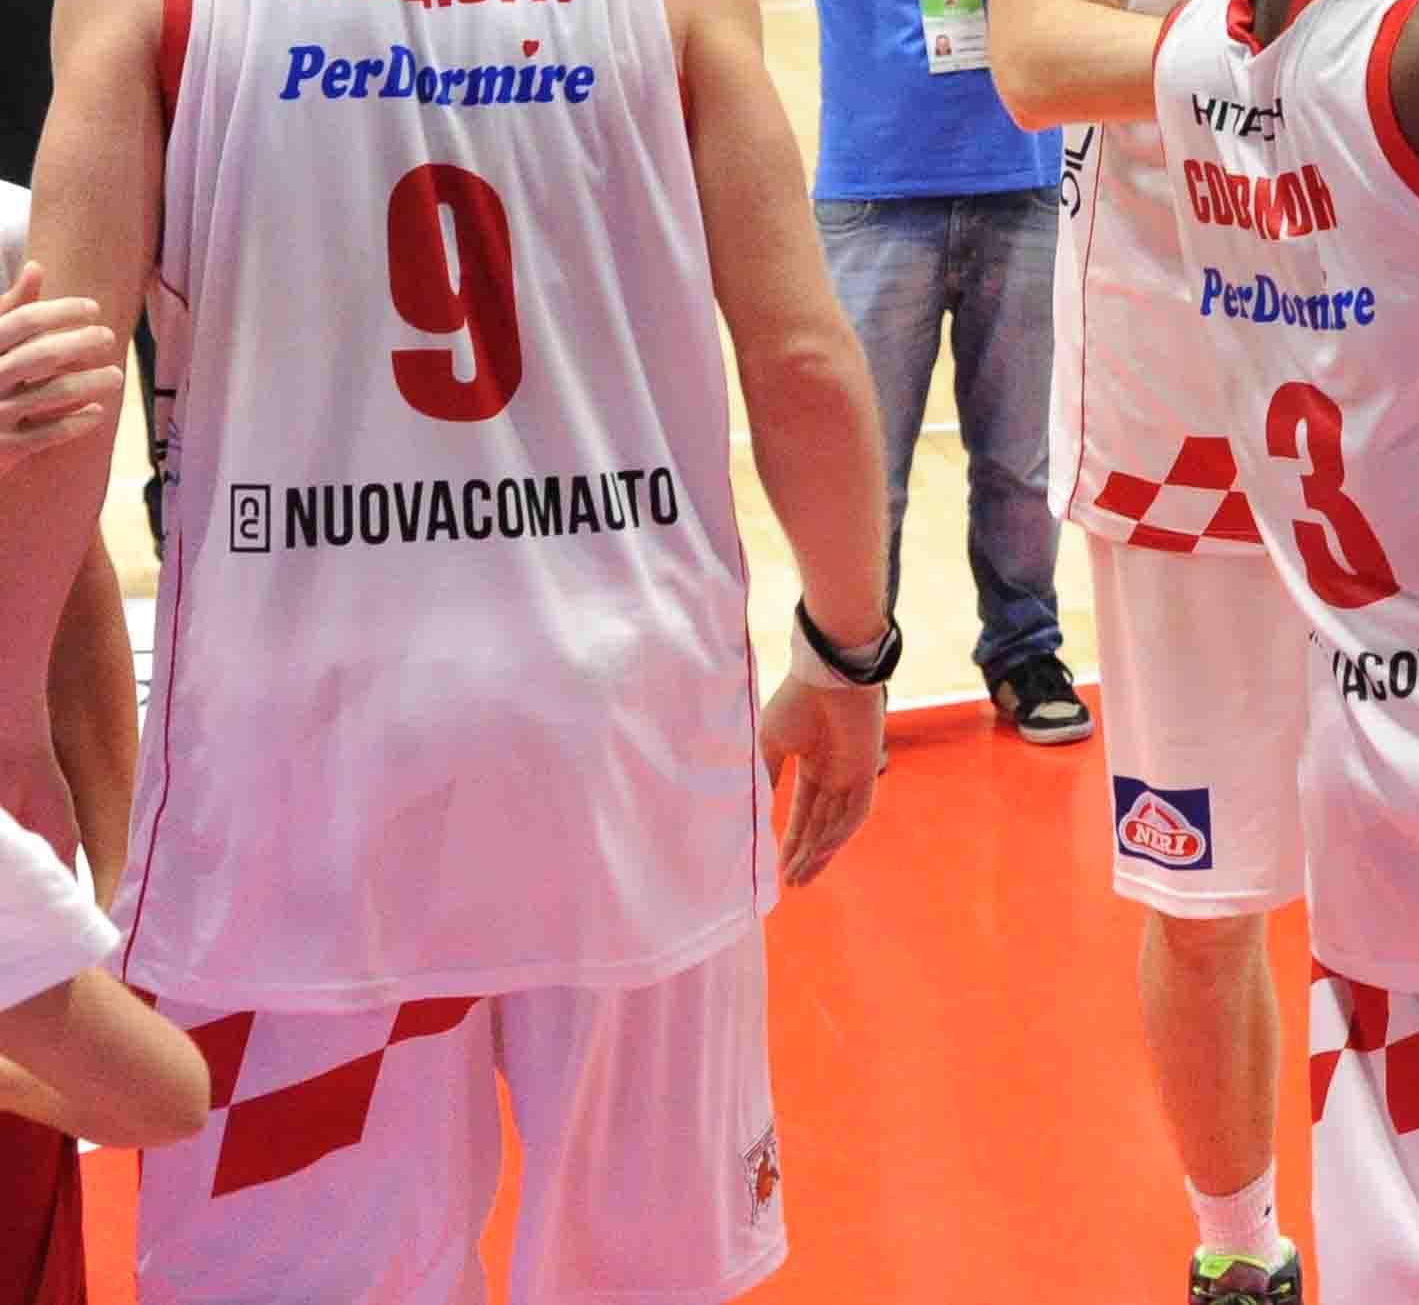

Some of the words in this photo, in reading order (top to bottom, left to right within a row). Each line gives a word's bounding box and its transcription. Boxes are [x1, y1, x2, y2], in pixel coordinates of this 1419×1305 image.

[280, 40, 595, 110] PerDormire
[387, 162, 524, 424] 9
[285, 466, 680, 552] NUOVACOMAUTO
[1265, 380, 1402, 611] 3
